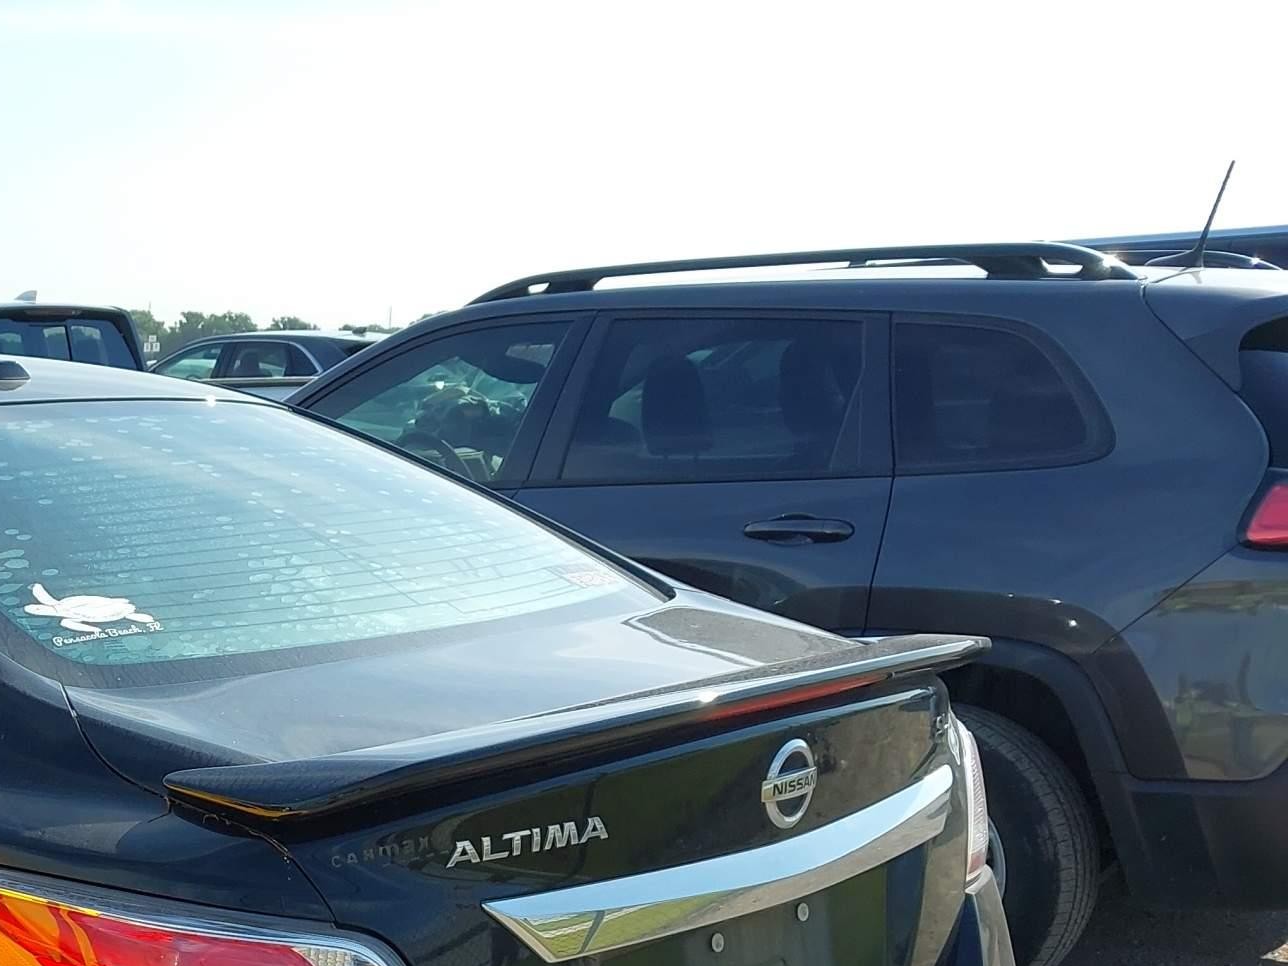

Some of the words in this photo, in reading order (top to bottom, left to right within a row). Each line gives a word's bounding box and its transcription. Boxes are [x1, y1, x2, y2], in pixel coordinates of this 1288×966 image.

[52, 630, 108, 647] Pensacola
[772, 773, 816, 797] NISSAN
[445, 815, 609, 869] ALTIMA
